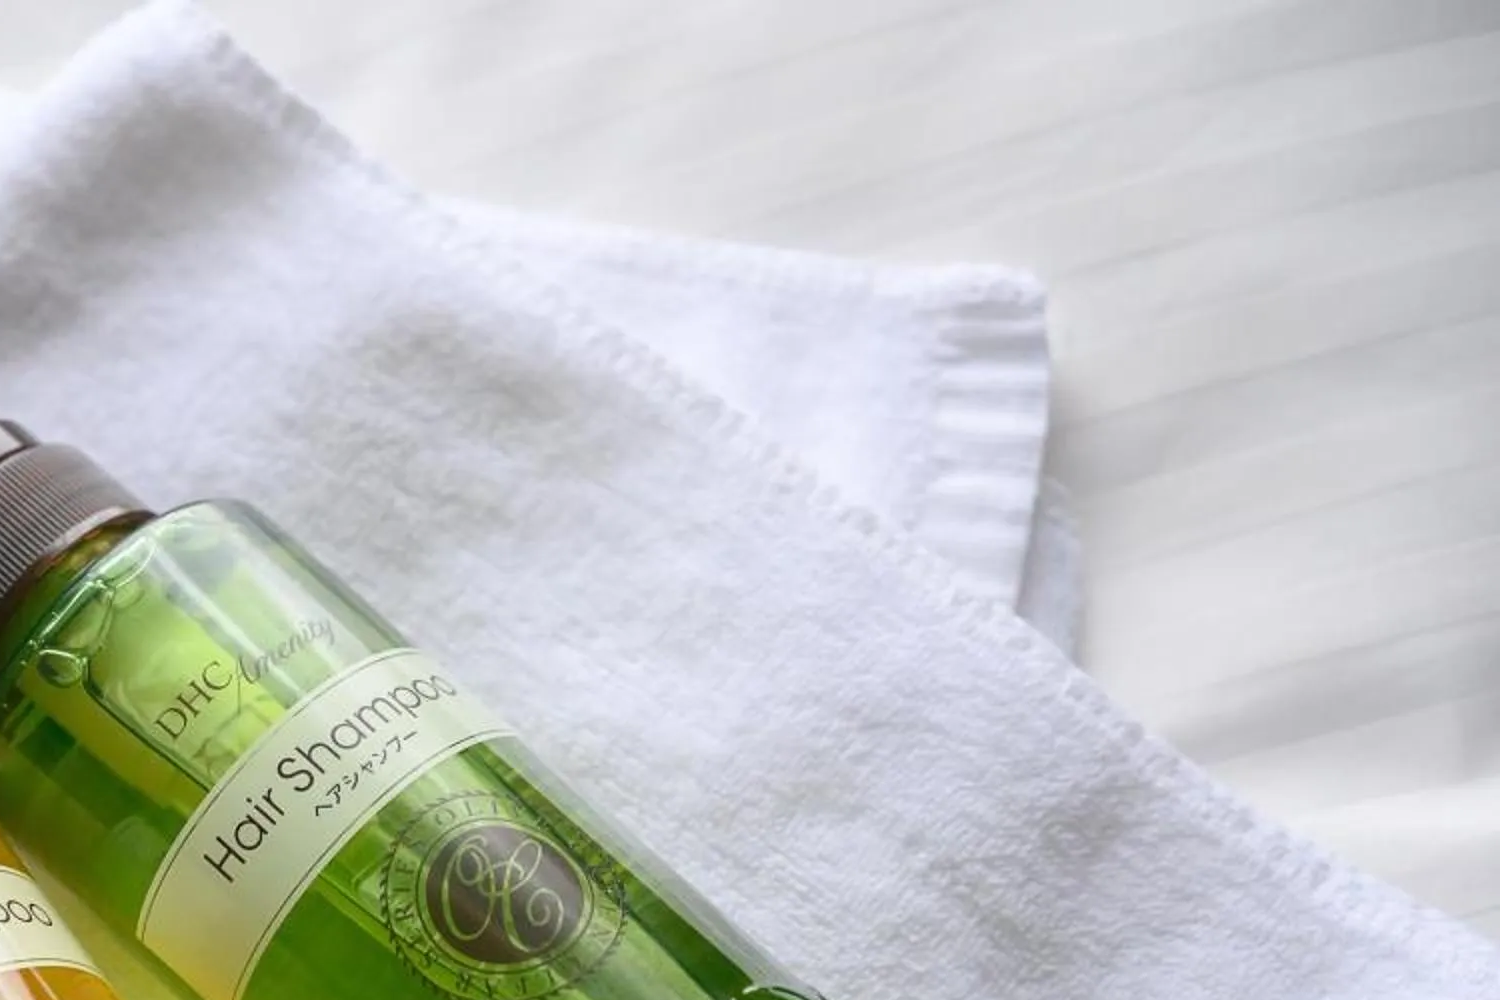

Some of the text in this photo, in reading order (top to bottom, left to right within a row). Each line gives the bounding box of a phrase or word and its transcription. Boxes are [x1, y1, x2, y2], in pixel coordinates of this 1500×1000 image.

[153, 617, 335, 741] DHC Amenity
[203, 674, 457, 883] Hair Shampoo
